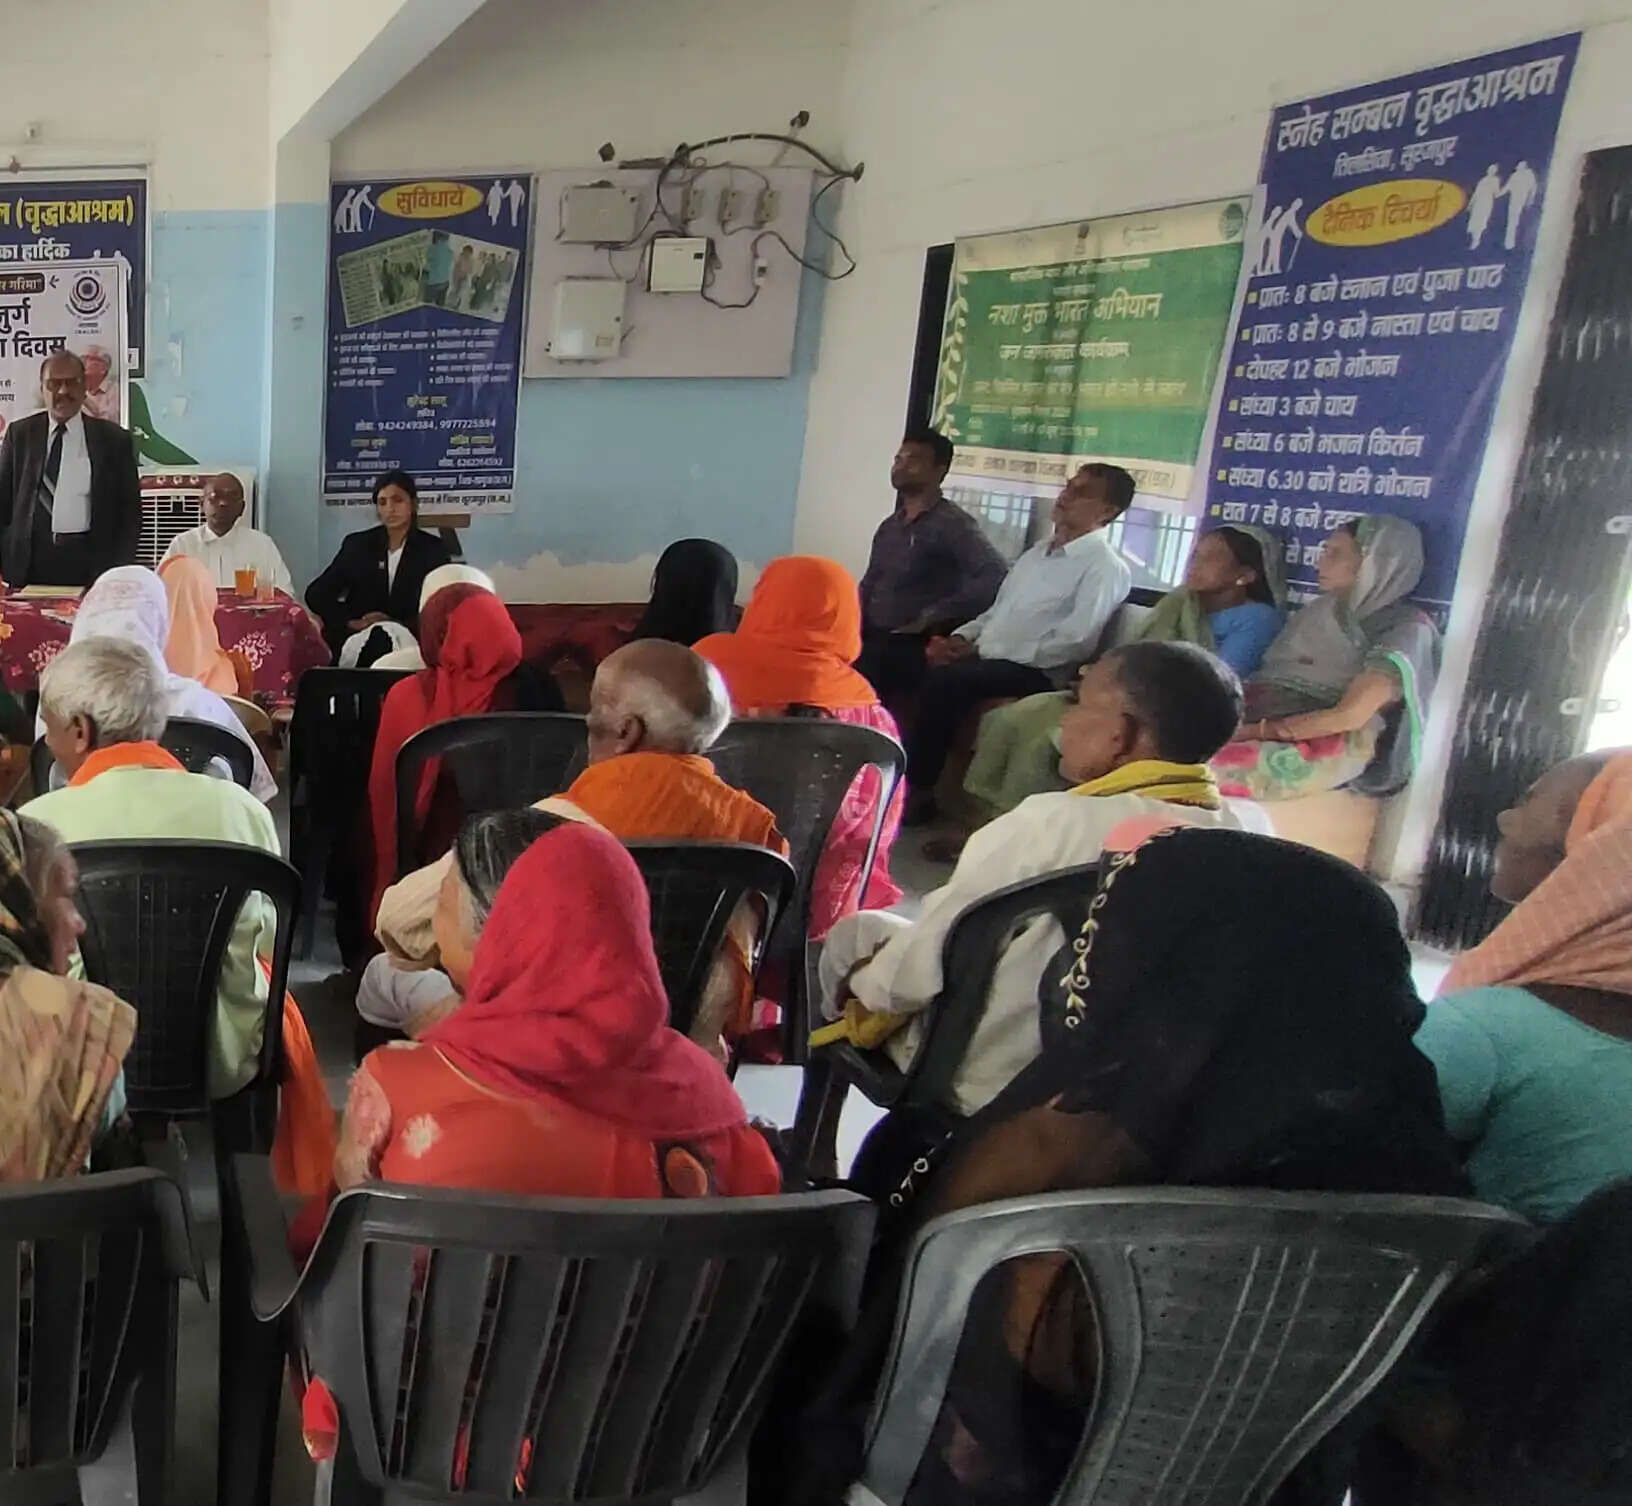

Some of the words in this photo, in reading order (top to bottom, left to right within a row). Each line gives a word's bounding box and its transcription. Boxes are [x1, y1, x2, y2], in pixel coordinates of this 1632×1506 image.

[1276, 104, 1329, 152] स्नेह
[1330, 91, 1412, 141] सम्बल
[16, 195, 134, 234] (वृद्धाआश्रम)
[20, 237, 71, 261] हार्दिक
[1294, 285, 1305, 304] 8
[1309, 274, 1338, 303] बजे
[1340, 275, 1390, 300] स्नान
[1467, 264, 1505, 289] पाठ
[988, 304, 1021, 326] नशा
[1052, 299, 1088, 324] भारत
[1093, 287, 1164, 321] अभियान
[1287, 324, 1298, 343] 8
[1302, 313, 1318, 342] से
[1321, 319, 1335, 341] 9
[1339, 310, 1367, 340] बजे
[1370, 313, 1425, 338] नास्ता
[1426, 307, 1459, 335] एवं
[1460, 307, 1504, 332] चाय
[12, 331, 67, 358] दिवस
[1246, 351, 1290, 380] दोपहर
[1293, 360, 1311, 379] 12
[1314, 350, 1342, 379] बजे
[1343, 349, 1400, 378] भोजन
[1240, 392, 1278, 416] संध्या
[1279, 397, 1291, 416] 3
[1294, 389, 1321, 416] बजे
[1324, 395, 1358, 416] चाय
[1234, 428, 1272, 452] संध्या
[1273, 433, 1284, 453] 6
[1288, 427, 1315, 453] बजे
[1317, 433, 1366, 455] भजन
[1368, 425, 1424, 457] किर्तन
[1228, 464, 1265, 486] संध्या
[1267, 469, 1304, 490] 6.30
[1307, 465, 1336, 492] बजे
[1338, 466, 1372, 495] रात्रि
[1373, 467, 1432, 499] भोजन
[1222, 501, 1247, 522] रात
[1249, 503, 1261, 524] 7
[1263, 498, 1278, 525] से
[1280, 506, 1292, 527] 8
[1294, 501, 1321, 530] बजे
